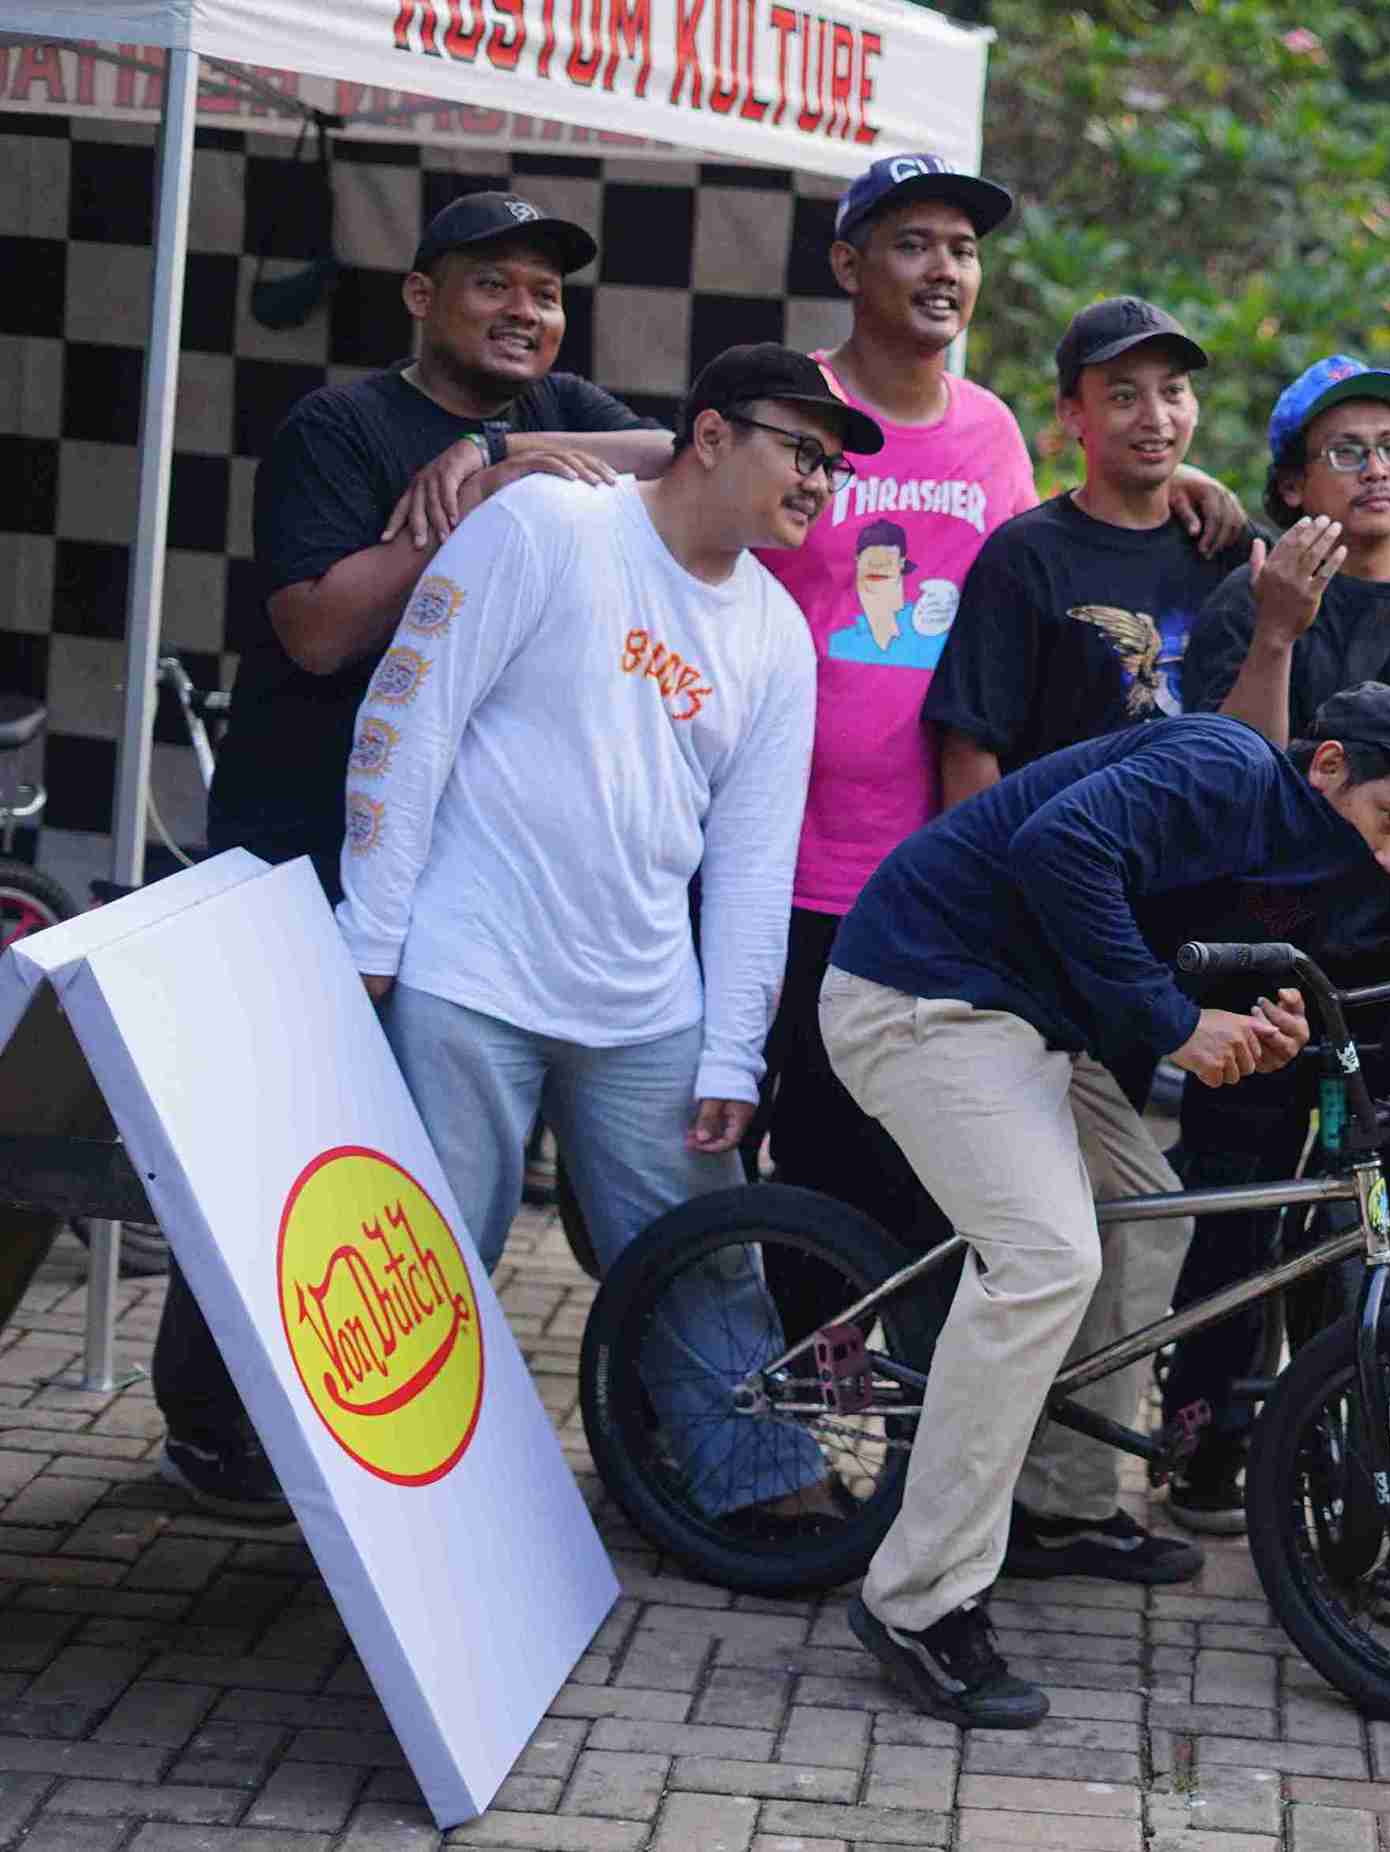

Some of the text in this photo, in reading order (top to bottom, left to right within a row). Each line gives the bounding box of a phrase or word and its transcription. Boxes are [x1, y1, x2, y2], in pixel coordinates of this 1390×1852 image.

[668, 0, 883, 147] KULTURE
[832, 474, 988, 536] THRASHER
[293, 1199, 466, 1393] Von Dutch
